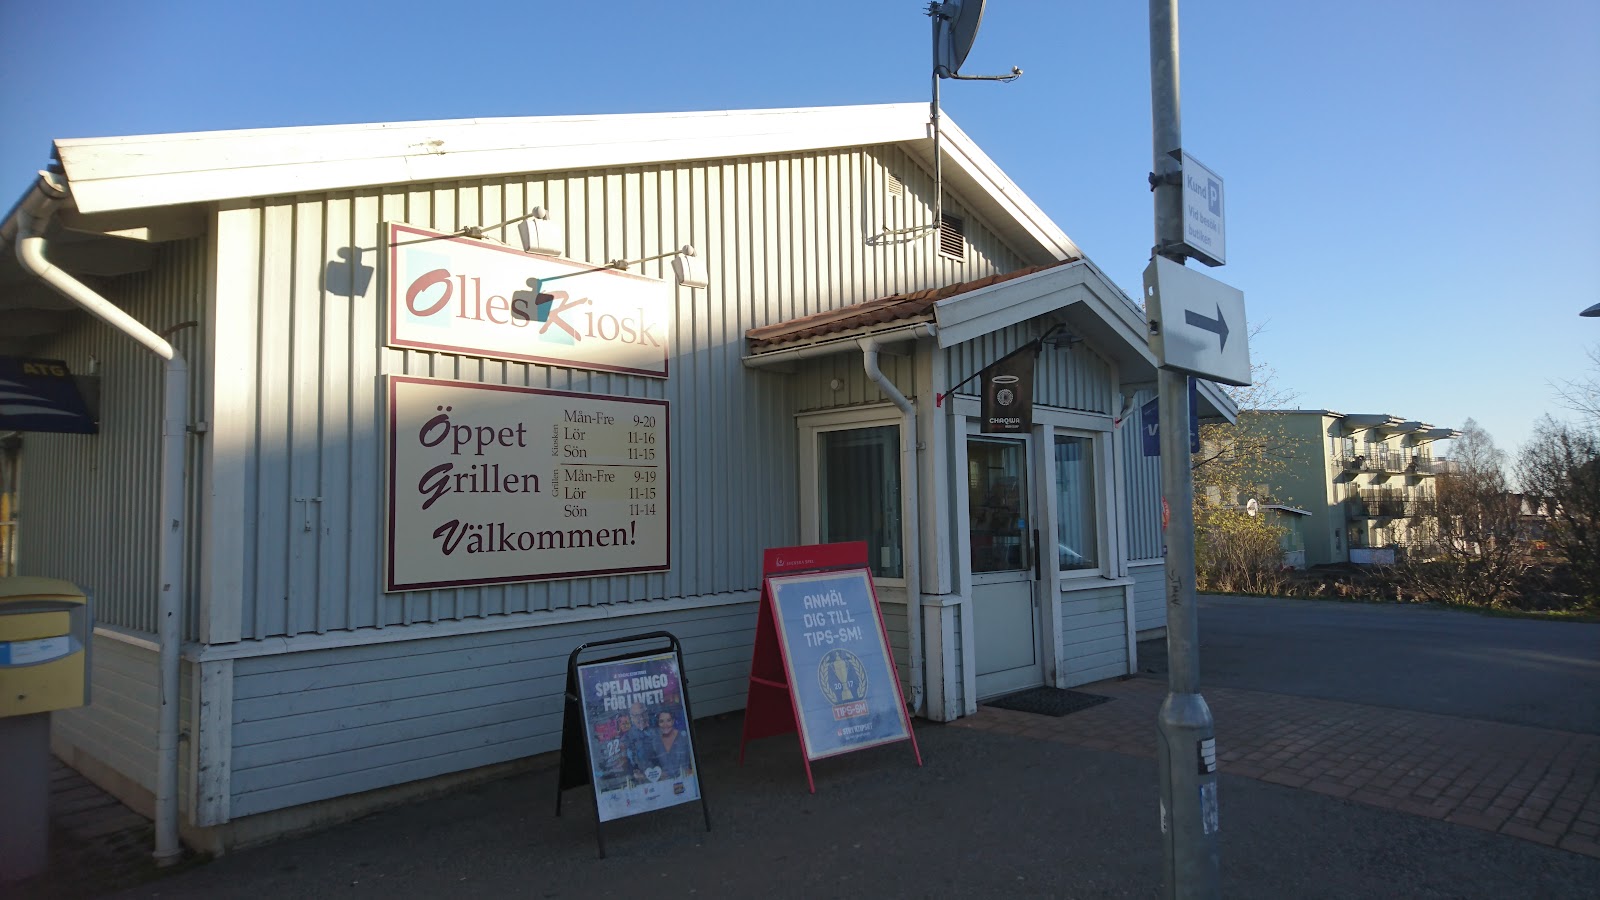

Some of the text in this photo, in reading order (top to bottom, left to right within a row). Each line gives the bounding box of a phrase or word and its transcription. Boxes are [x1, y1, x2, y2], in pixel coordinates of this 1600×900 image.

[1187, 175, 1206, 199] Kund
[1188, 205, 1198, 220] Vid
[1200, 212, 1217, 232] besök
[1188, 224, 1211, 246] butiken
[406, 268, 660, 347] Olles Kiosk
[564, 409, 656, 428] Mån-Fre 9-20
[989, 417, 1020, 425] CHAQWA
[418, 405, 527, 455] Öppet
[551, 424, 559, 457] Kiosken
[564, 427, 655, 445] Lör 11-16
[564, 444, 655, 460] Sön 11-15
[418, 462, 541, 510] Grillen
[551, 469, 559, 497] Grillen
[564, 468, 656, 483] Mån-Fre 9-19
[564, 487, 656, 500] Lör 11-15
[564, 504, 656, 518] Sön 11-14
[432, 519, 636, 556] Välkommen!
[803, 590, 847, 610] ANMÄL
[803, 609, 856, 629] DIG TILL
[803, 626, 863, 648] TIPS-SM!
[595, 678, 632, 697] SPELA
[632, 673, 669, 691] BINGO
[603, 695, 627, 712] FÖR
[834, 703, 867, 717] TIPS-SM
